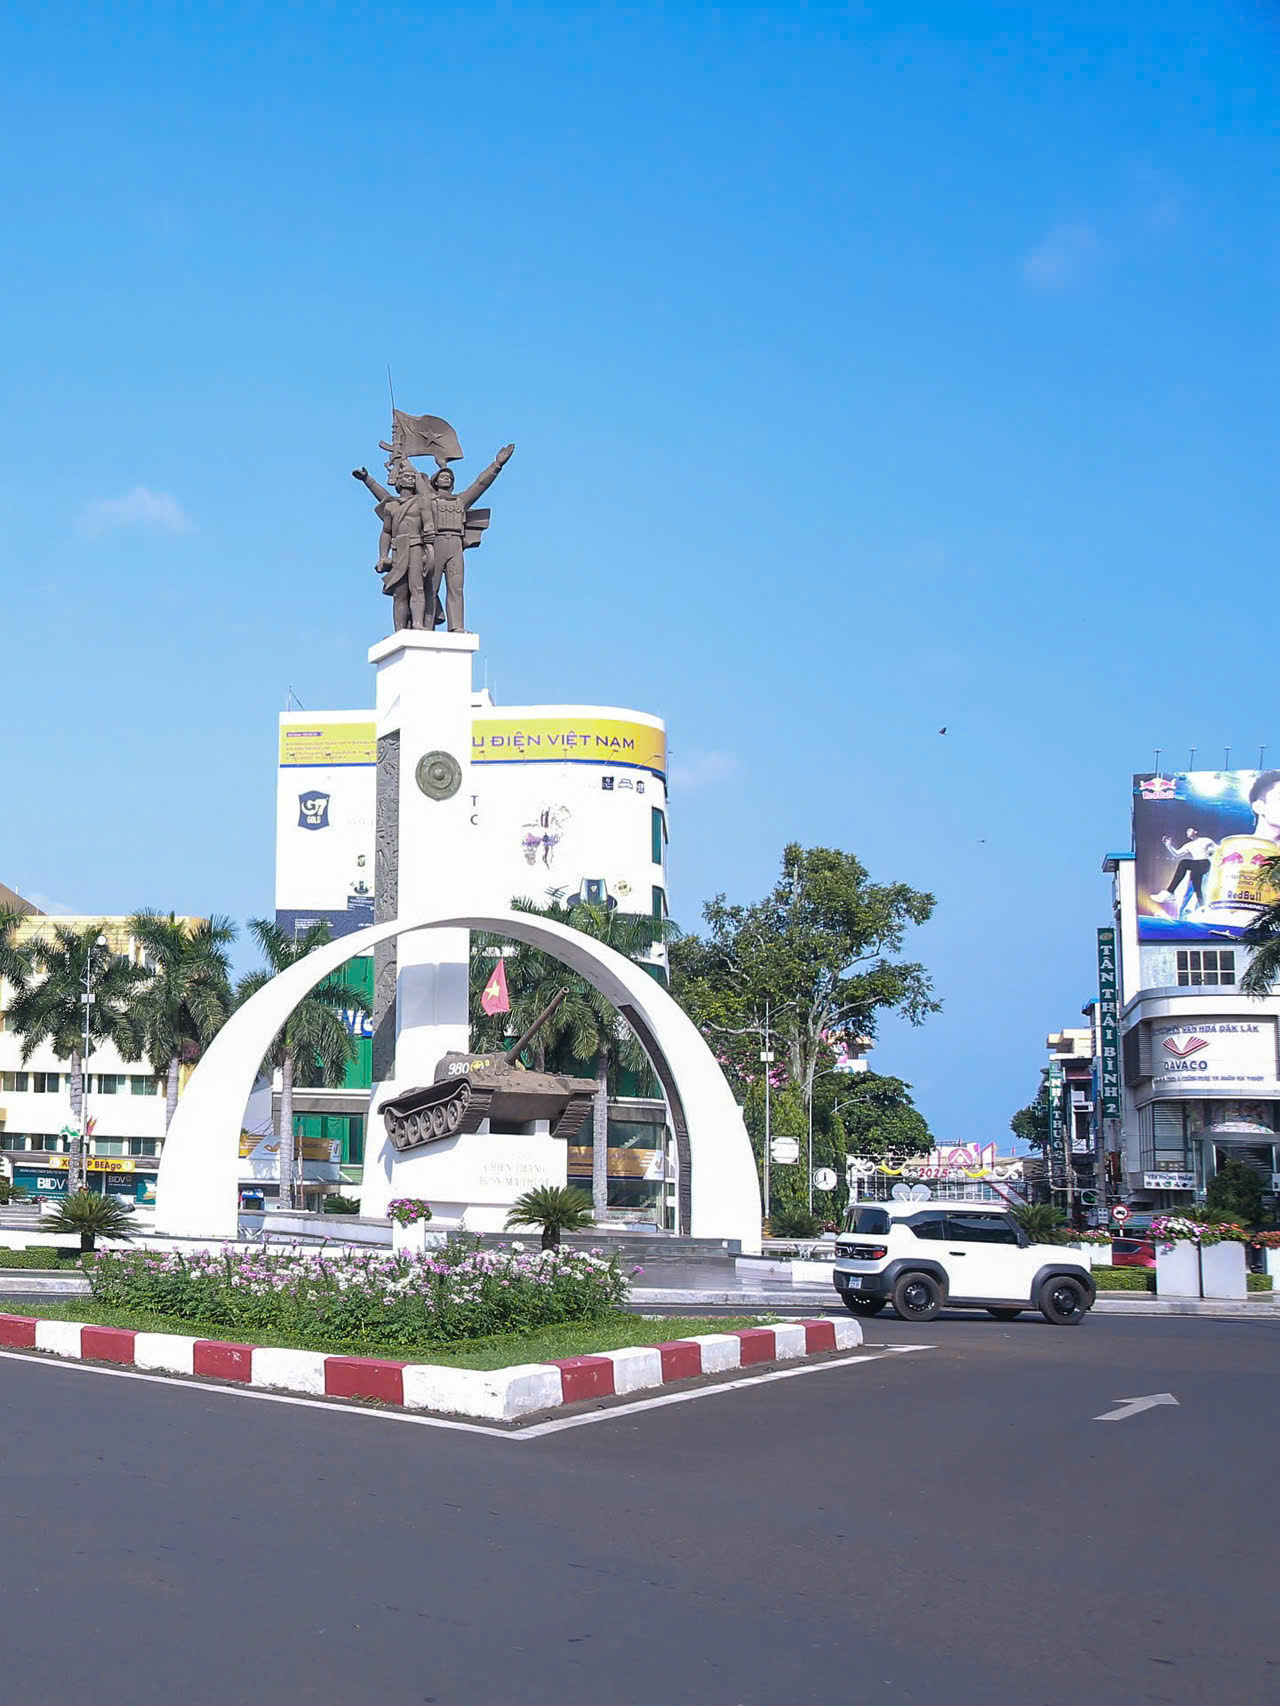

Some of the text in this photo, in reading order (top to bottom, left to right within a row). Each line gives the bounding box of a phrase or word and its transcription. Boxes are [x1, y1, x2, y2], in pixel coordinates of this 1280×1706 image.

[491, 731, 541, 750] ĐIỆN
[547, 731, 591, 749] VIỆT
[596, 735, 635, 750] NAM
[1101, 988, 1116, 1040] THÁI
[448, 1062, 470, 1075] 980
[1103, 1046, 1118, 1097] BÌNH
[1163, 1061, 1208, 1072] DAVACO
[1106, 1103, 1117, 1113] 2
[108, 1175, 126, 1183] BIDV
[919, 1168, 948, 1178] 2025
[37, 1177, 66, 1190] BIDV
